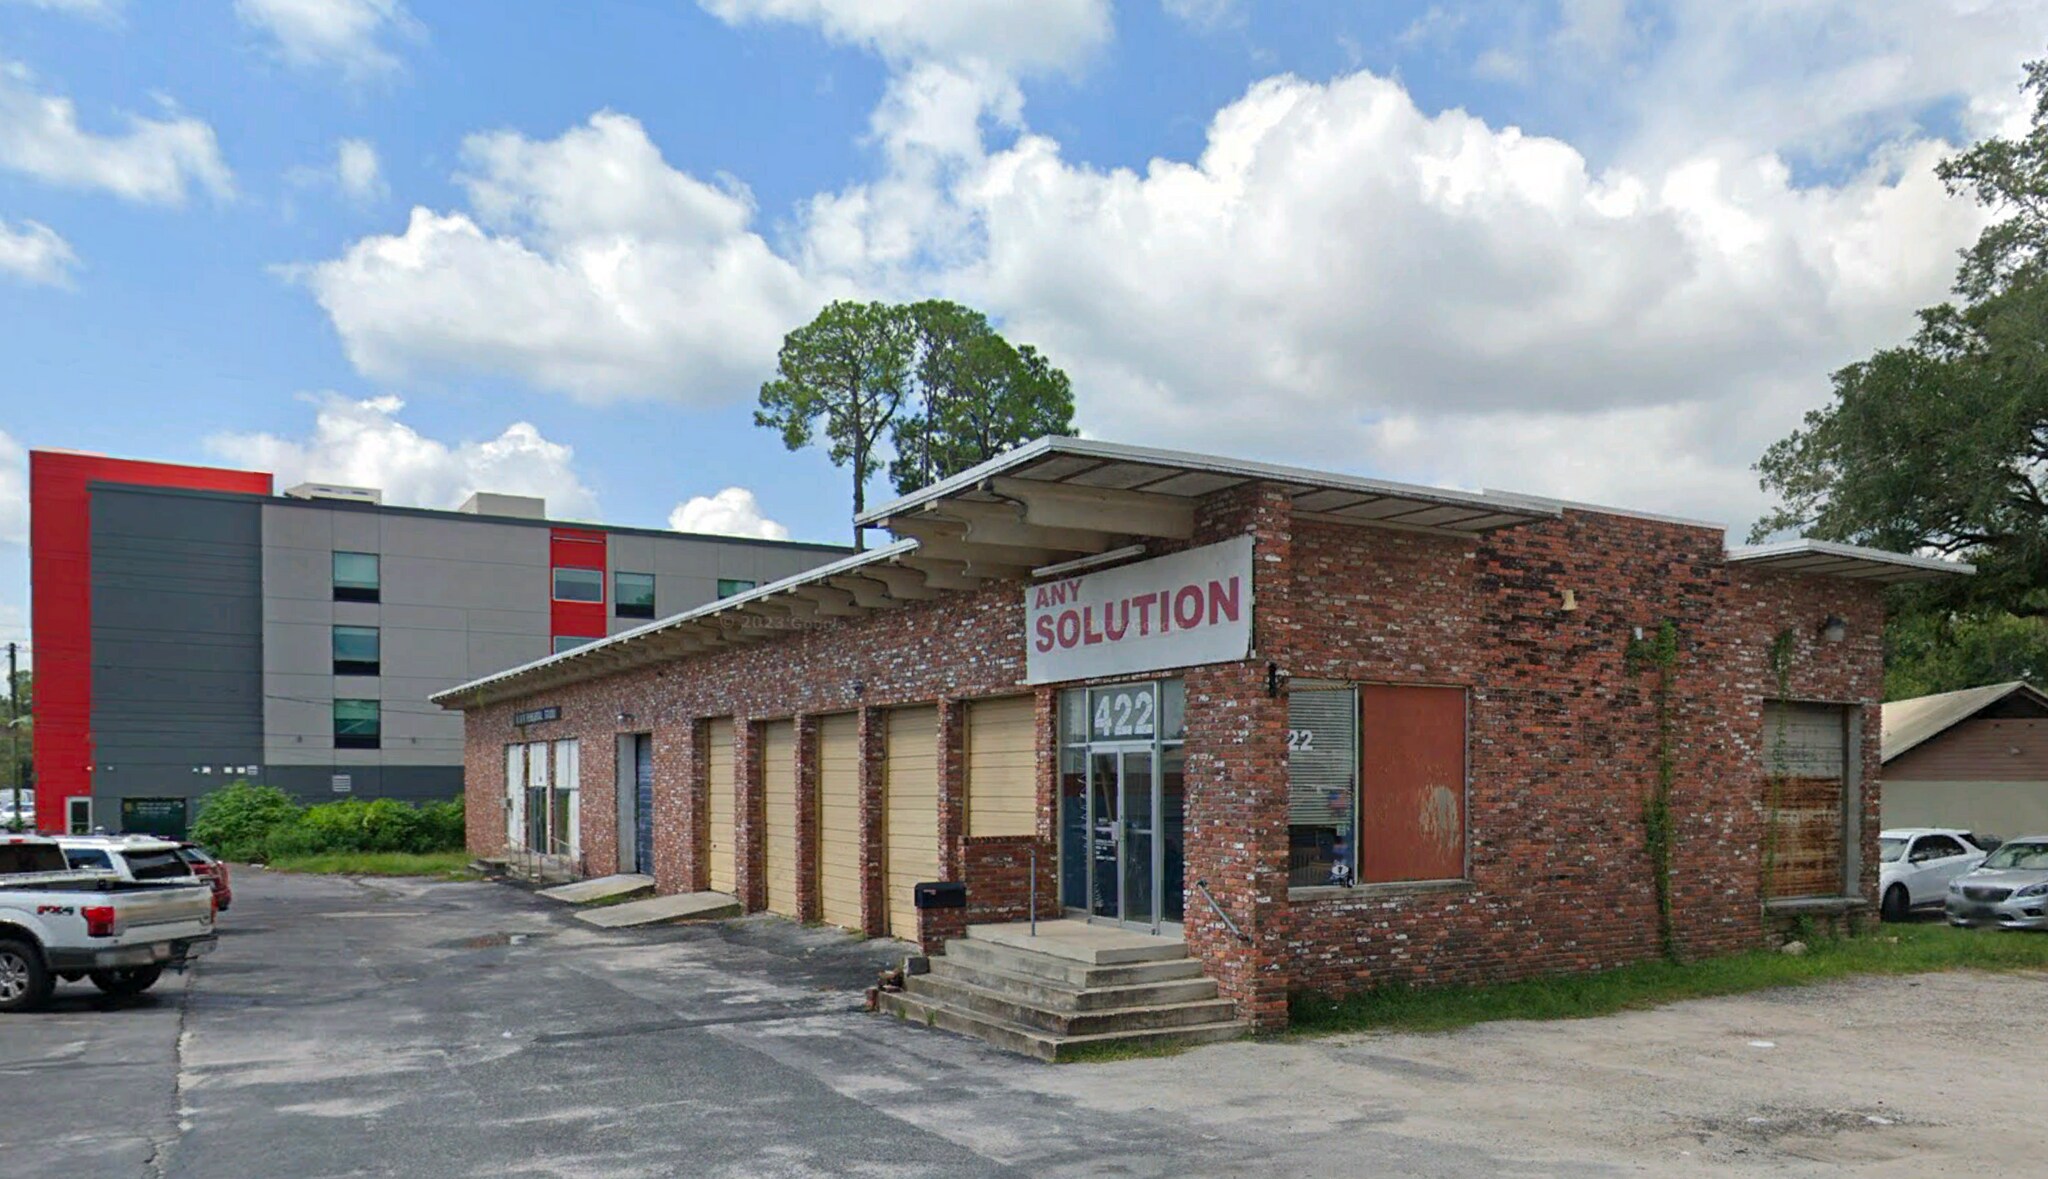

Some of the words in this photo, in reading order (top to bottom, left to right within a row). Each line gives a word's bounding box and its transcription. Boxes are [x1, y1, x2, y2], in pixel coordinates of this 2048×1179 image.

[1035, 579, 1083, 610] ANY
[1035, 576, 1240, 653] SOLUTION
[1094, 691, 1154, 737] 422
[36, 905, 75, 916] FX4
